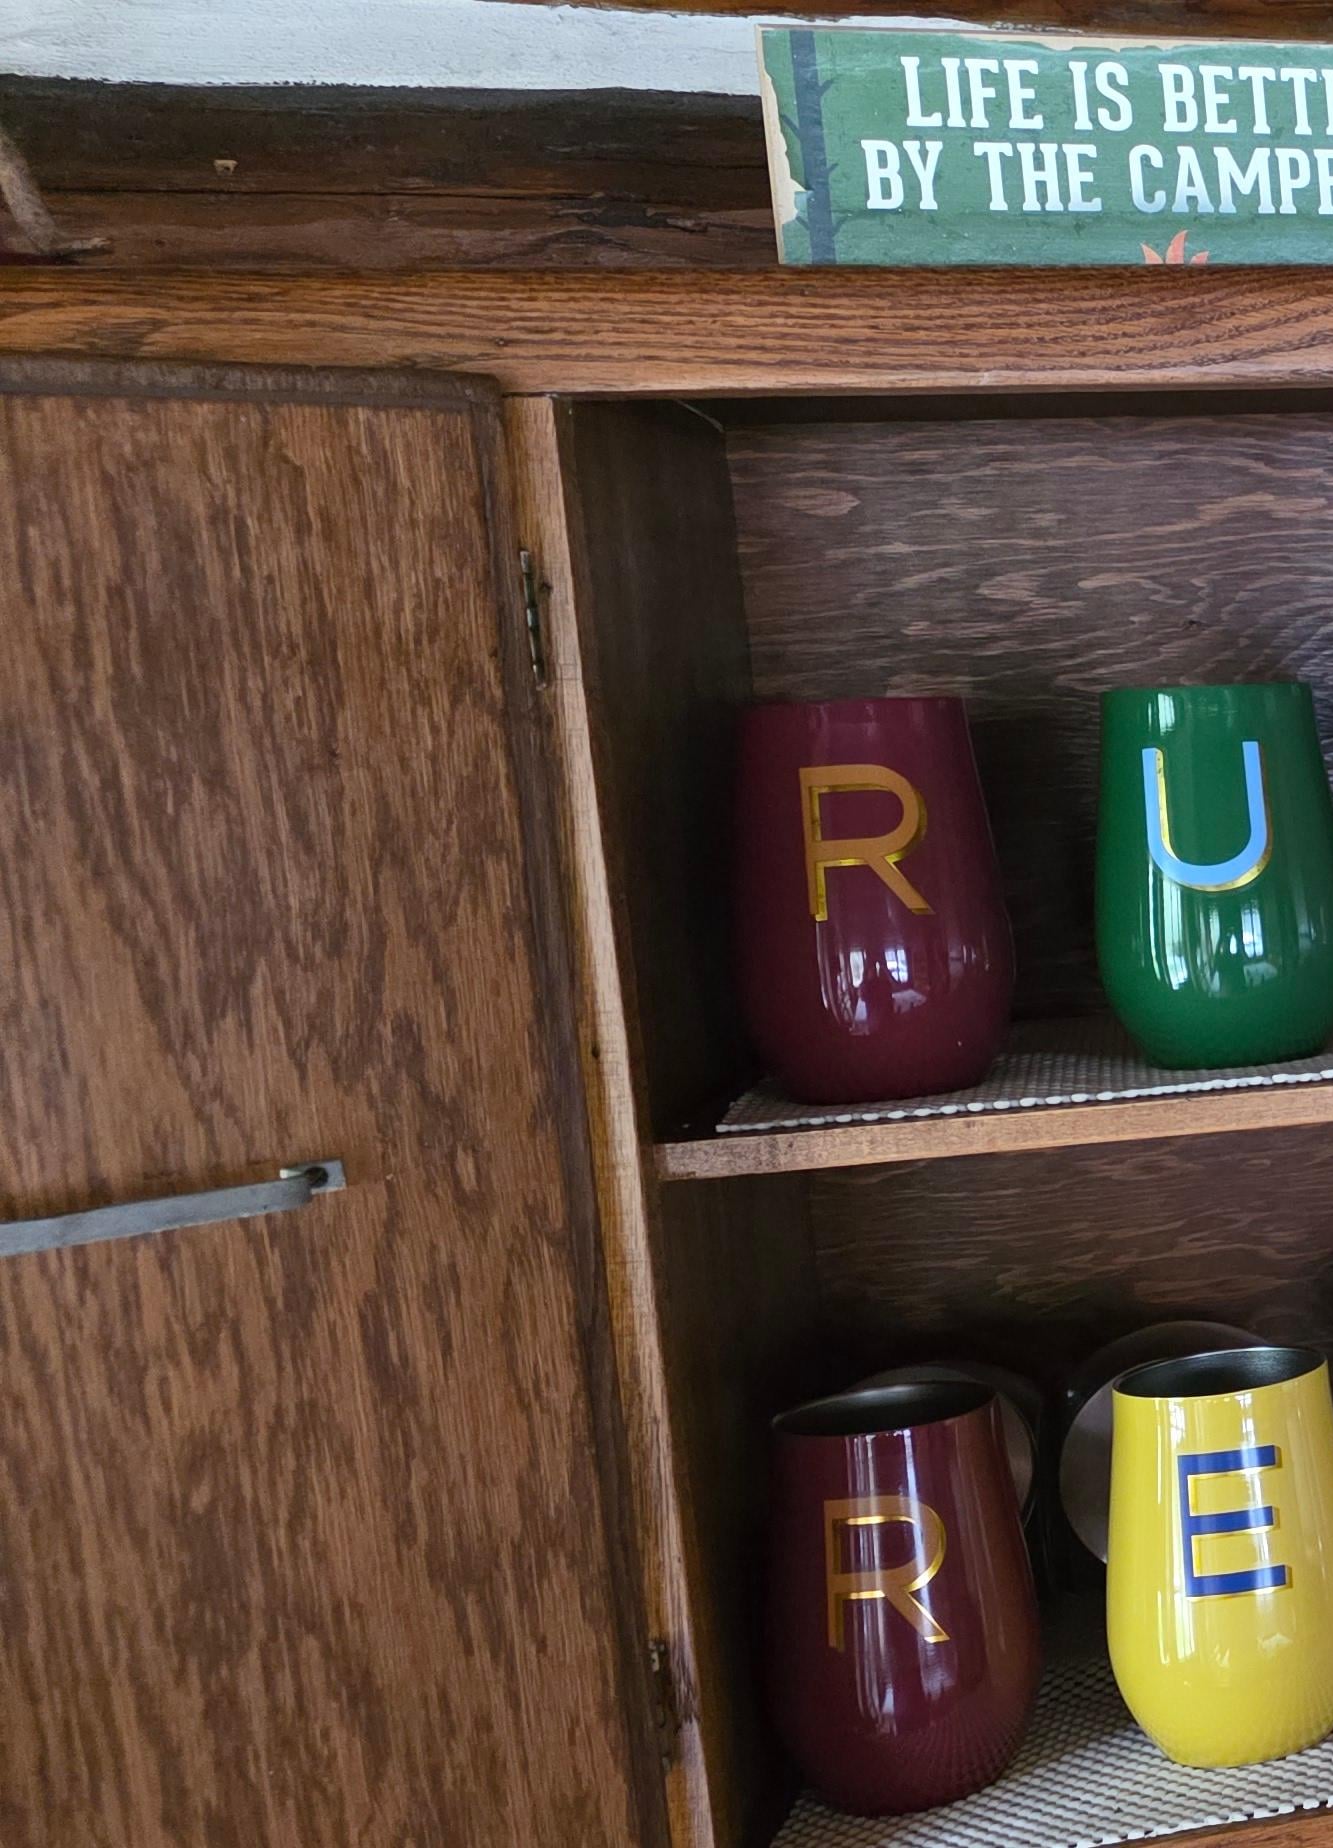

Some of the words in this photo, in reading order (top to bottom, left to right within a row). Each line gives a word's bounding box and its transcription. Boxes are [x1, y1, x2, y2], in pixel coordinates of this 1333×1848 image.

[899, 55, 1044, 130] LIFE
[1067, 60, 1134, 132] IS
[860, 139, 944, 211] BY
[972, 141, 1103, 212] THE
[799, 763, 935, 922] R
[1141, 740, 1274, 892] U
[823, 1494, 950, 1653] R
[1176, 1443, 1294, 1602] E
